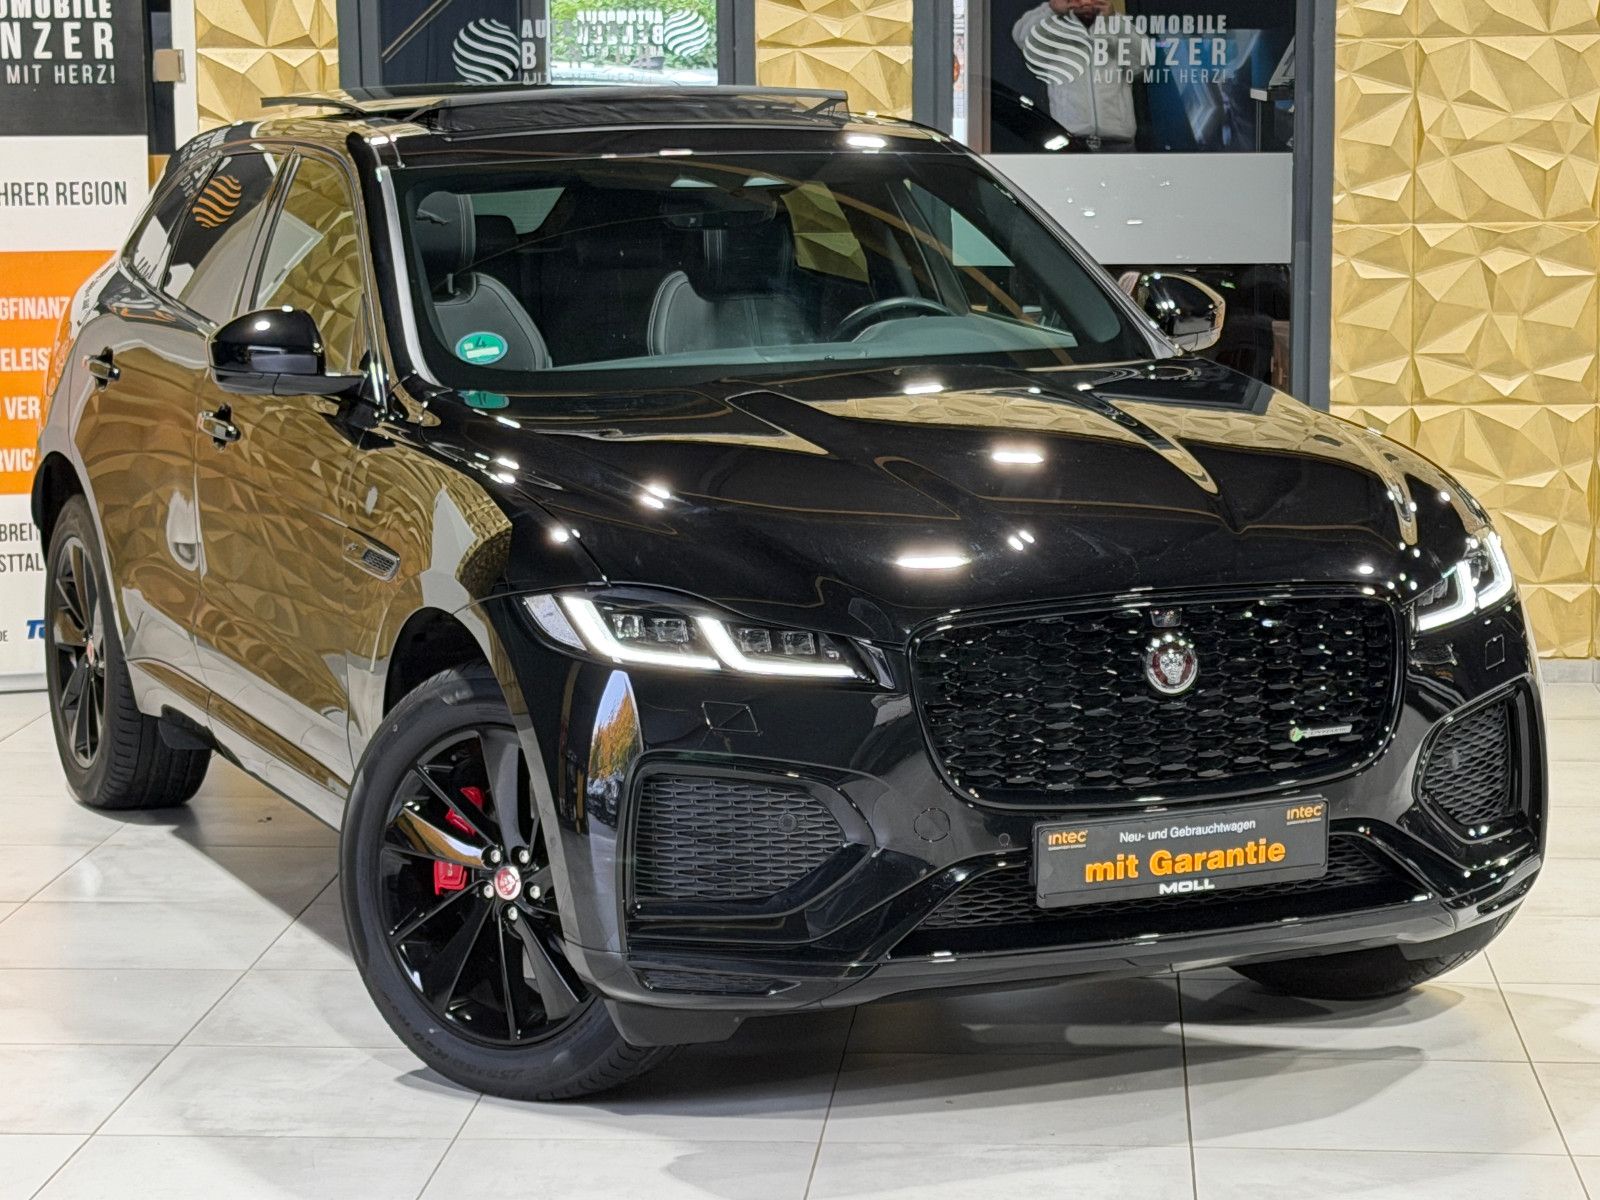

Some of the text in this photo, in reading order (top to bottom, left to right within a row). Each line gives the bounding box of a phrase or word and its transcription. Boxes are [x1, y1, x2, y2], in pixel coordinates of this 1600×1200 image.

[1093, 14, 1227, 35] AUTOMOBILE
[0, 21, 115, 60] NZER
[1093, 37, 1227, 66] BENZER
[6, 64, 116, 85] MIT HERZ!
[1093, 67, 1227, 84] AUTO MIT HERZ!
[55, 181, 128, 206] REGION
[0, 347, 51, 372] ELEIS
[1147, 827, 1168, 841] und
[1169, 819, 1256, 838] Gebrauchtwagen
[1085, 837, 1287, 883] mit Garantie
[1158, 878, 1216, 896] MOLL
